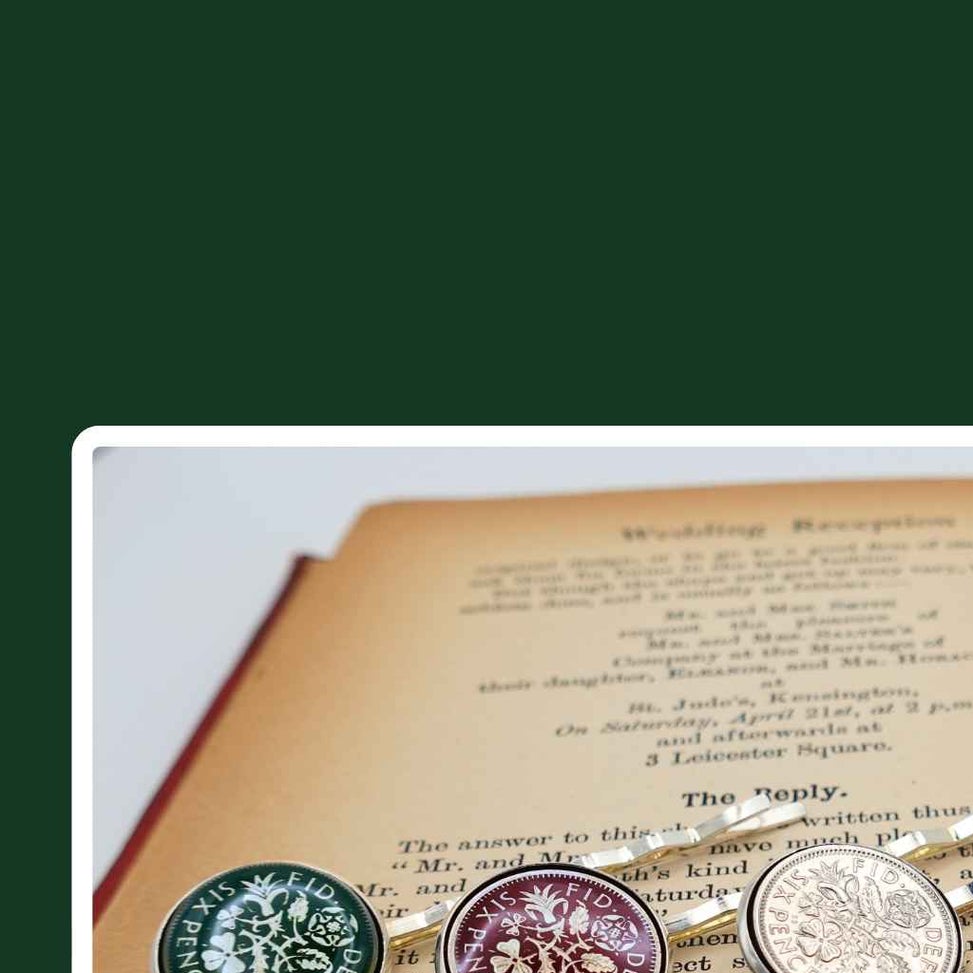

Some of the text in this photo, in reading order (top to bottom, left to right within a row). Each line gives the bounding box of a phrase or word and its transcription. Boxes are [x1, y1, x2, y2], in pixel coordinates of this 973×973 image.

[555, 725, 588, 738] On
[729, 709, 795, 726] April
[656, 723, 883, 748] and afterwards at
[645, 742, 893, 767] 3 Leicester Square.
[681, 791, 737, 808] The
[801, 808, 900, 827] written
[398, 831, 589, 855] The answer to
[475, 854, 524, 869] and
[686, 860, 748, 878] kind
[416, 878, 467, 894] and
[395, 950, 419, 966] it
